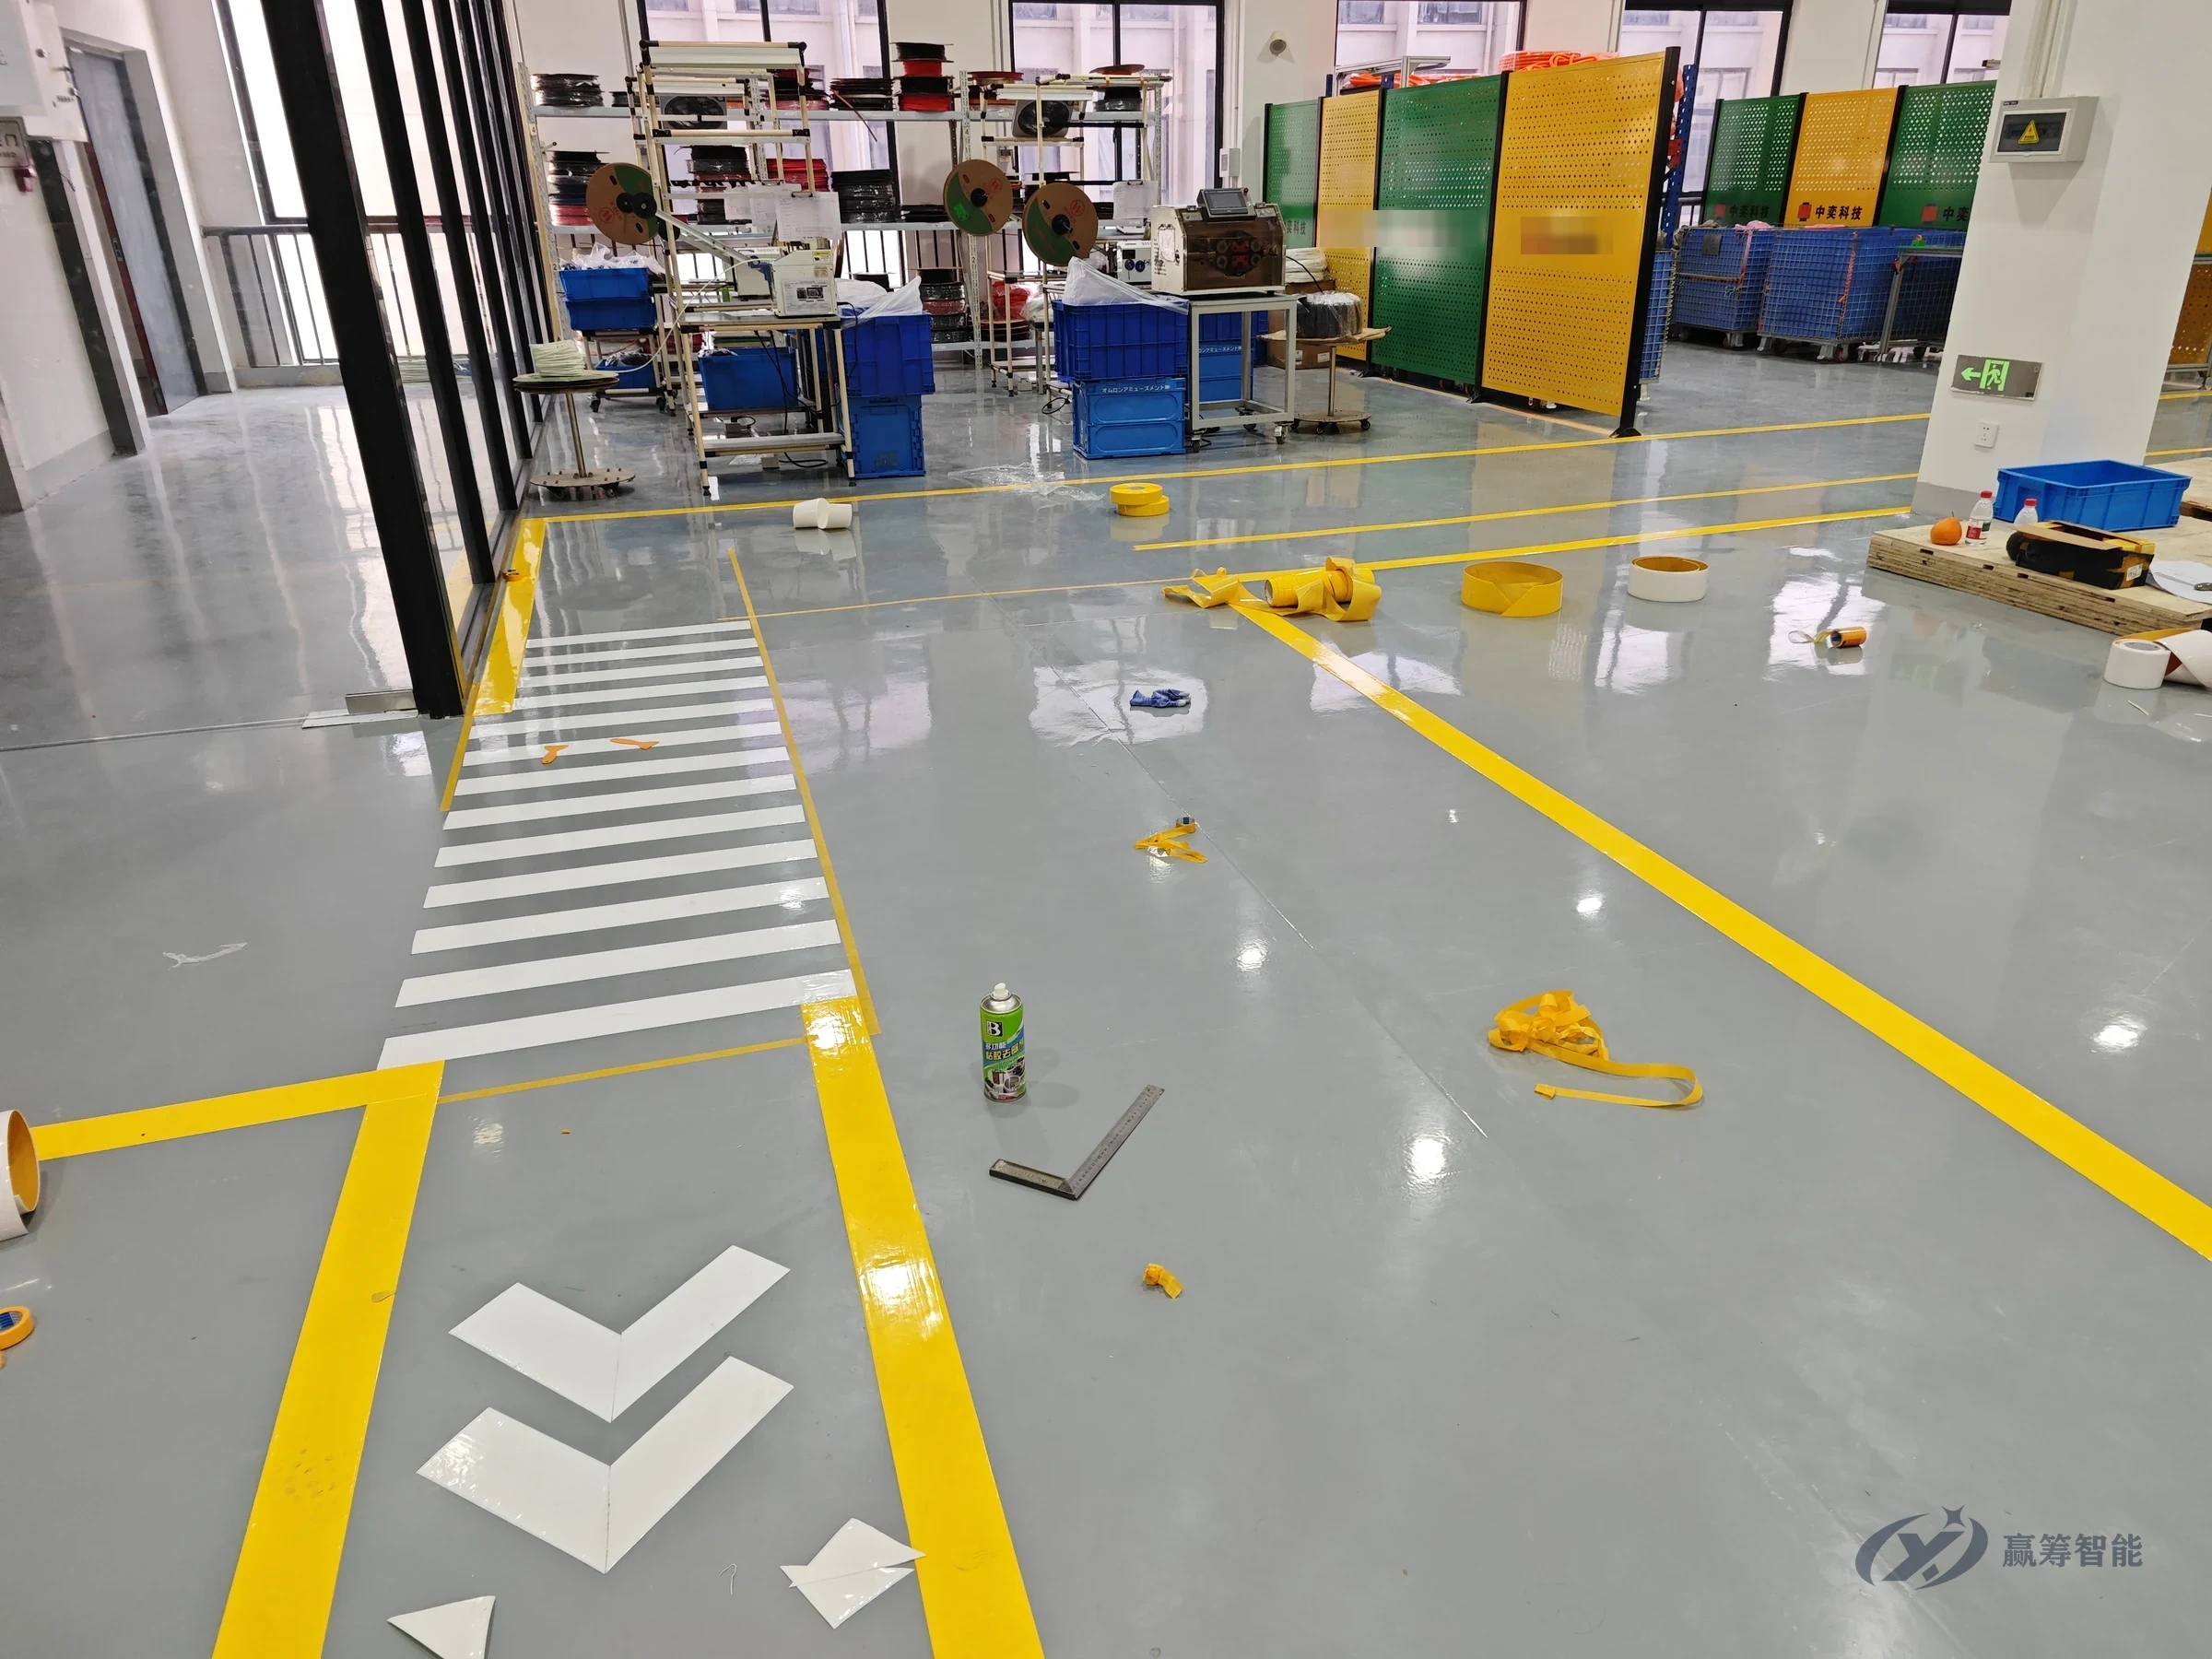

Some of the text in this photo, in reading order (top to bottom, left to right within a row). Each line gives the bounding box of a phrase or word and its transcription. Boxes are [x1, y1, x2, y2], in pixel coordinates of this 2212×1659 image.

[1815, 205, 1863, 220] 中奕科技
[987, 1020, 1001, 1036] B
